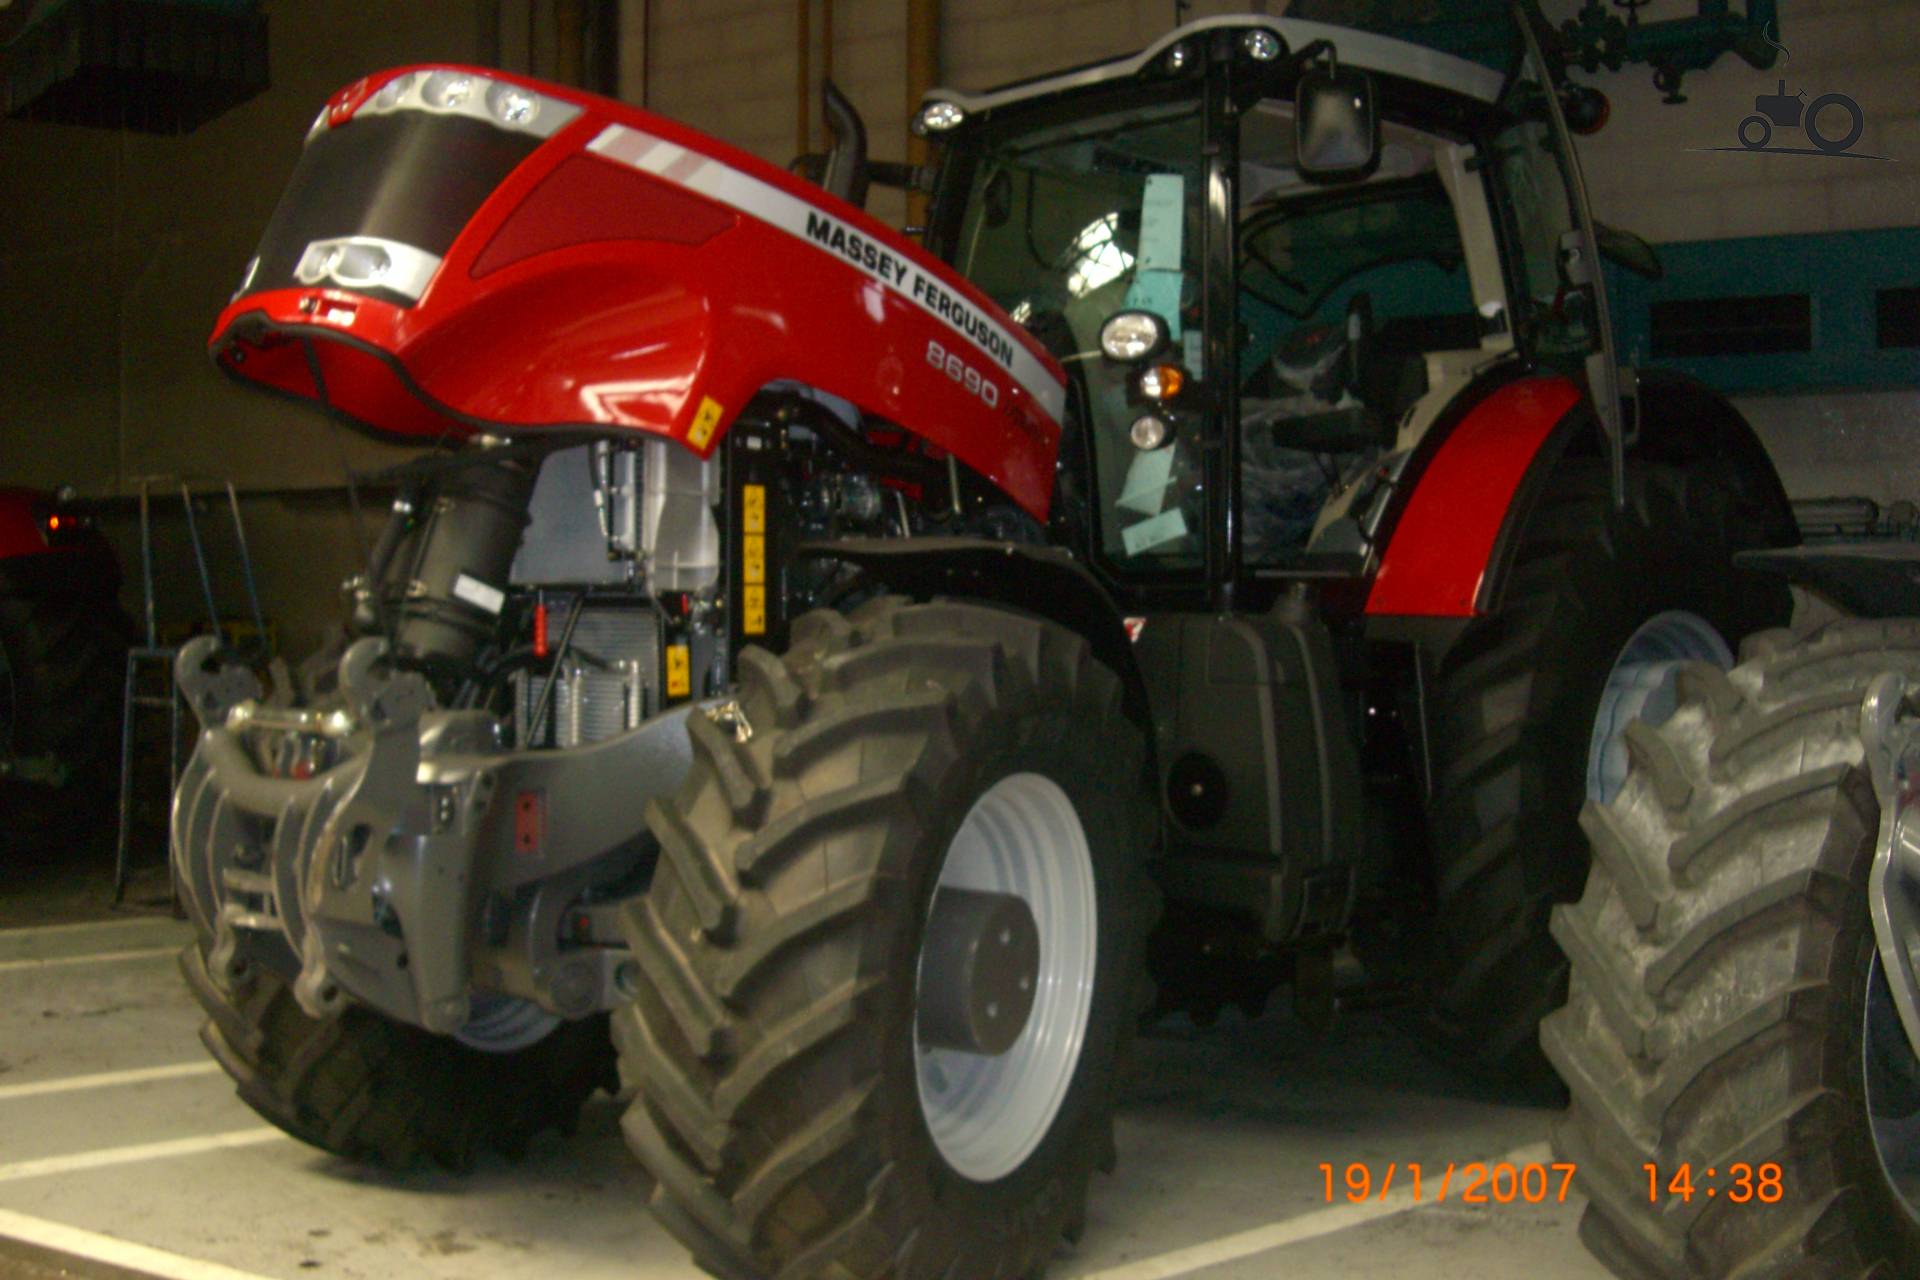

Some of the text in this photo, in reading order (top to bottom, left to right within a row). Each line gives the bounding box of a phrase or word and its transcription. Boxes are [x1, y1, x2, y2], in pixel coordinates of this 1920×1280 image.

[806, 212, 1014, 369] MASSEY FERGUSON
[926, 340, 998, 409] 8690
